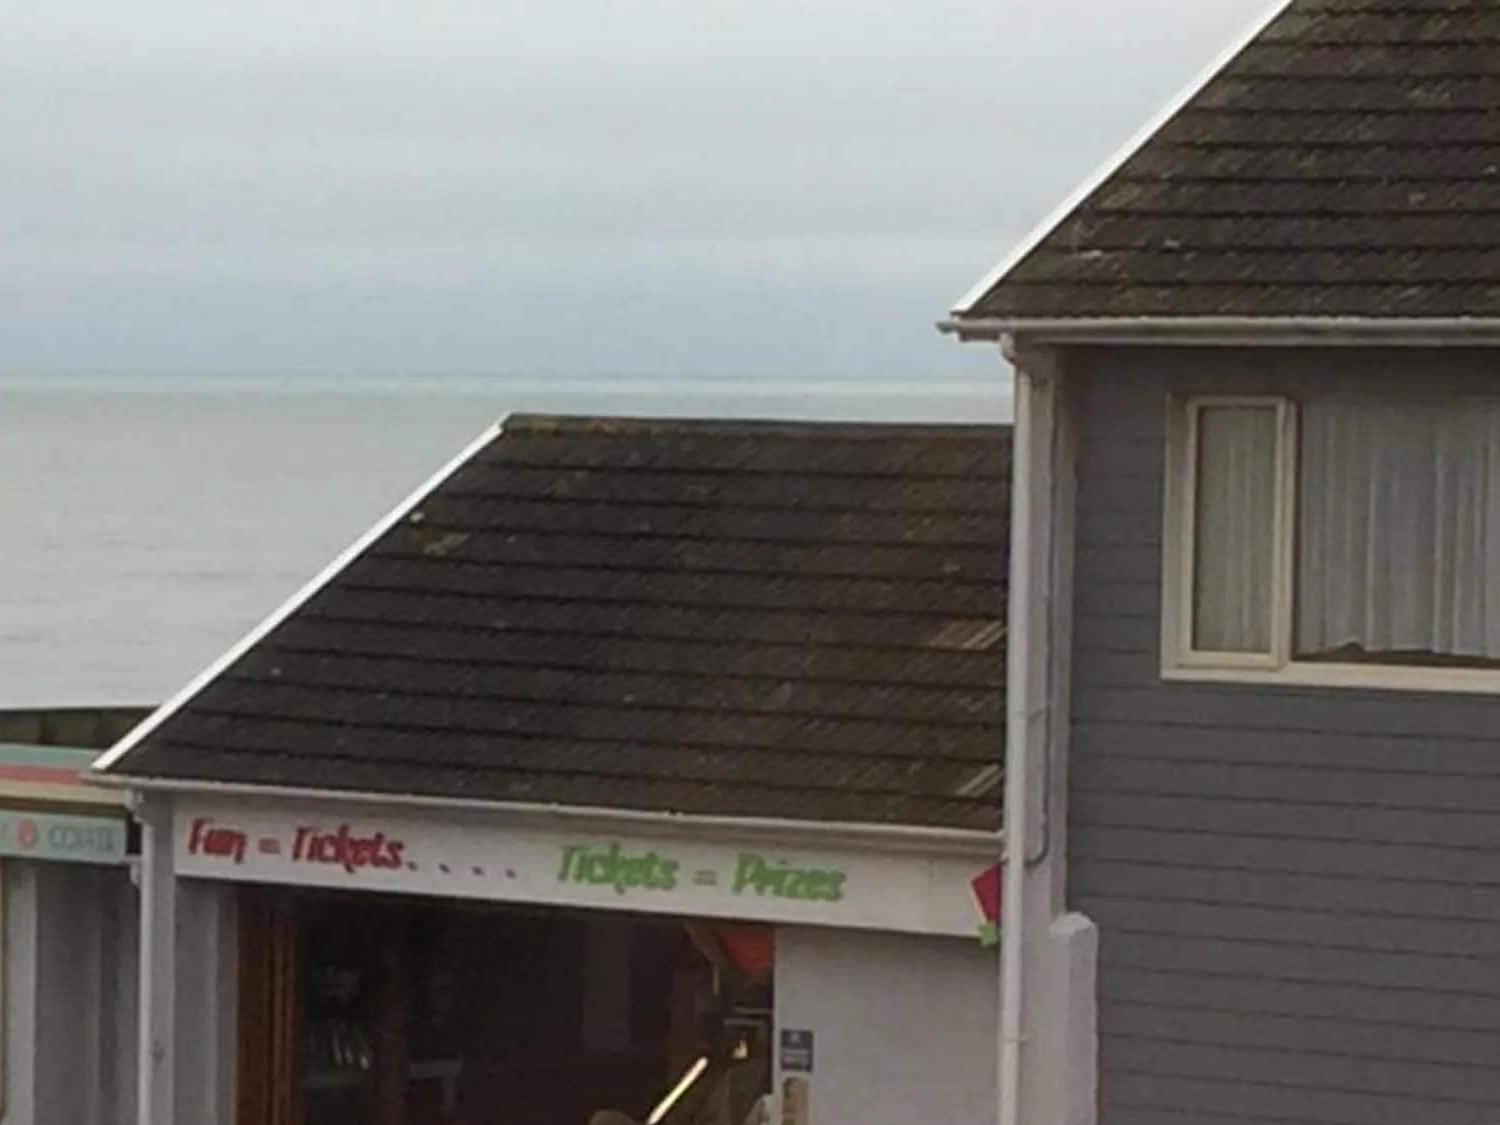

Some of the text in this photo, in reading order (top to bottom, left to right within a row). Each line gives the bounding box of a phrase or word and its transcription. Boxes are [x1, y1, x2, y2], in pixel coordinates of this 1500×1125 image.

[187, 817, 248, 865] Fun
[556, 841, 680, 896] Tickets
[730, 852, 848, 902] Prizes
